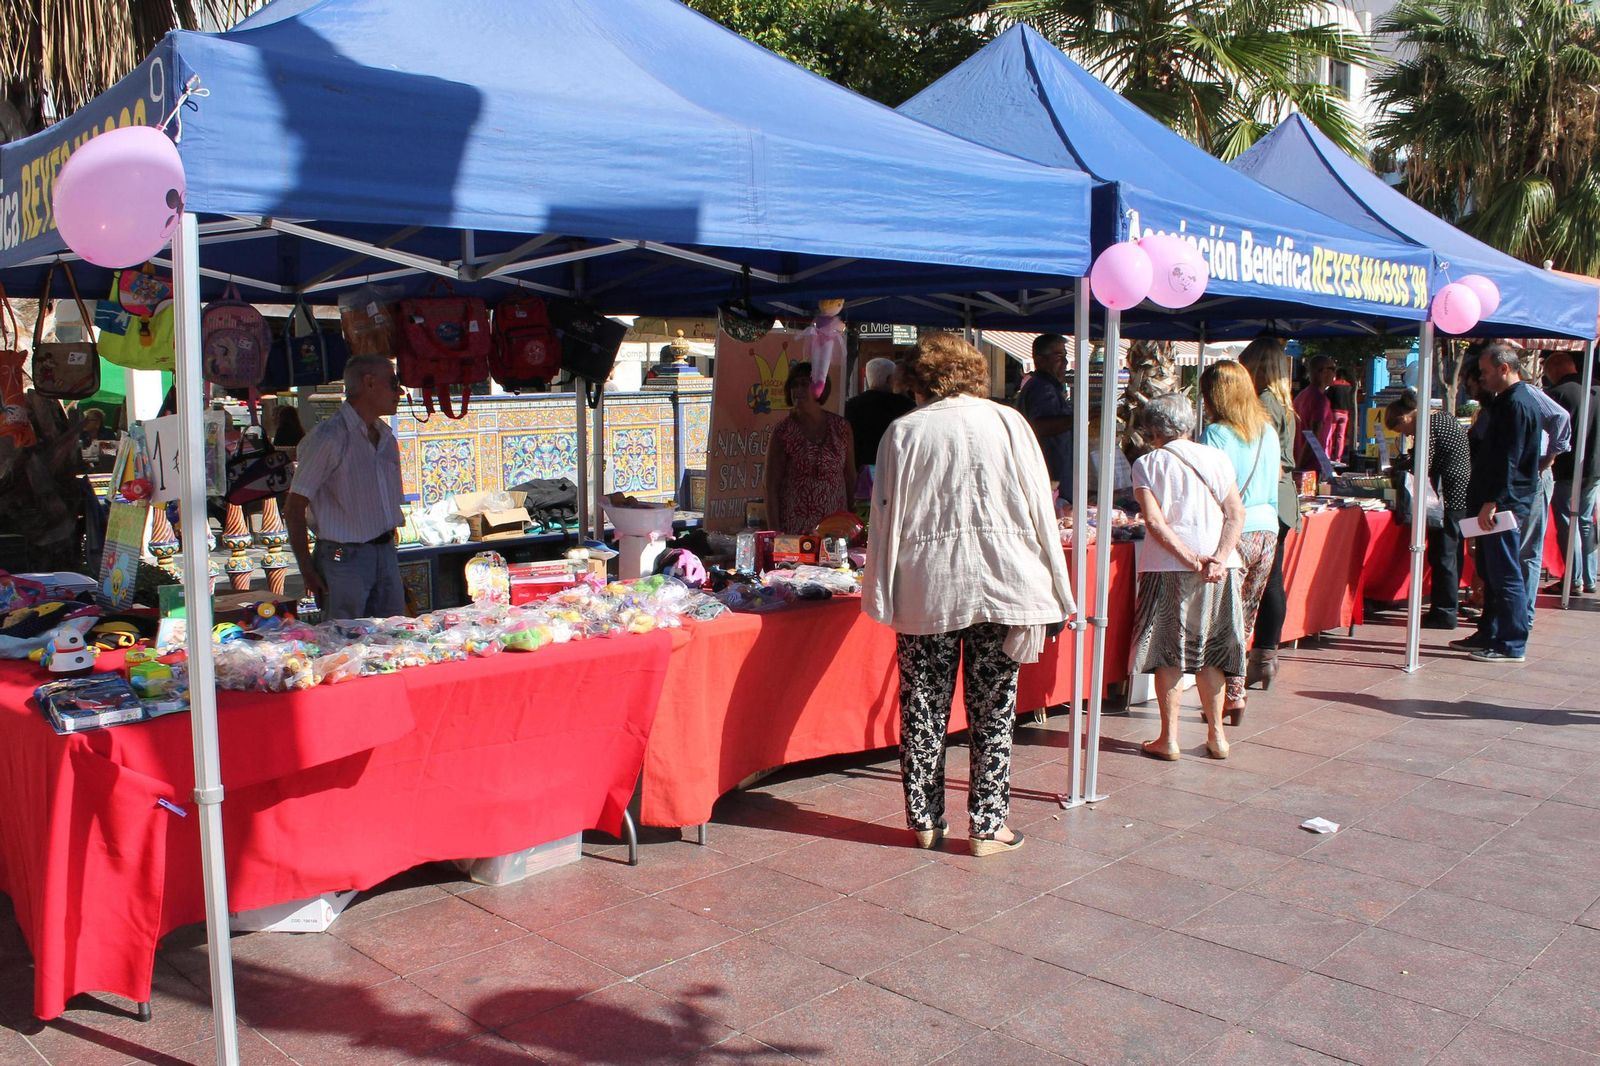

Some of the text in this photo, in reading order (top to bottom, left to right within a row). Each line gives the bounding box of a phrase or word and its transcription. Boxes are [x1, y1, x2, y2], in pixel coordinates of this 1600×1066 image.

[21, 140, 72, 242] REYE
[1241, 230, 1313, 292] Benéfica
[1312, 245, 1362, 300] REYES
[1361, 256, 1410, 307] MAGOS
[719, 461, 748, 492] SIN
